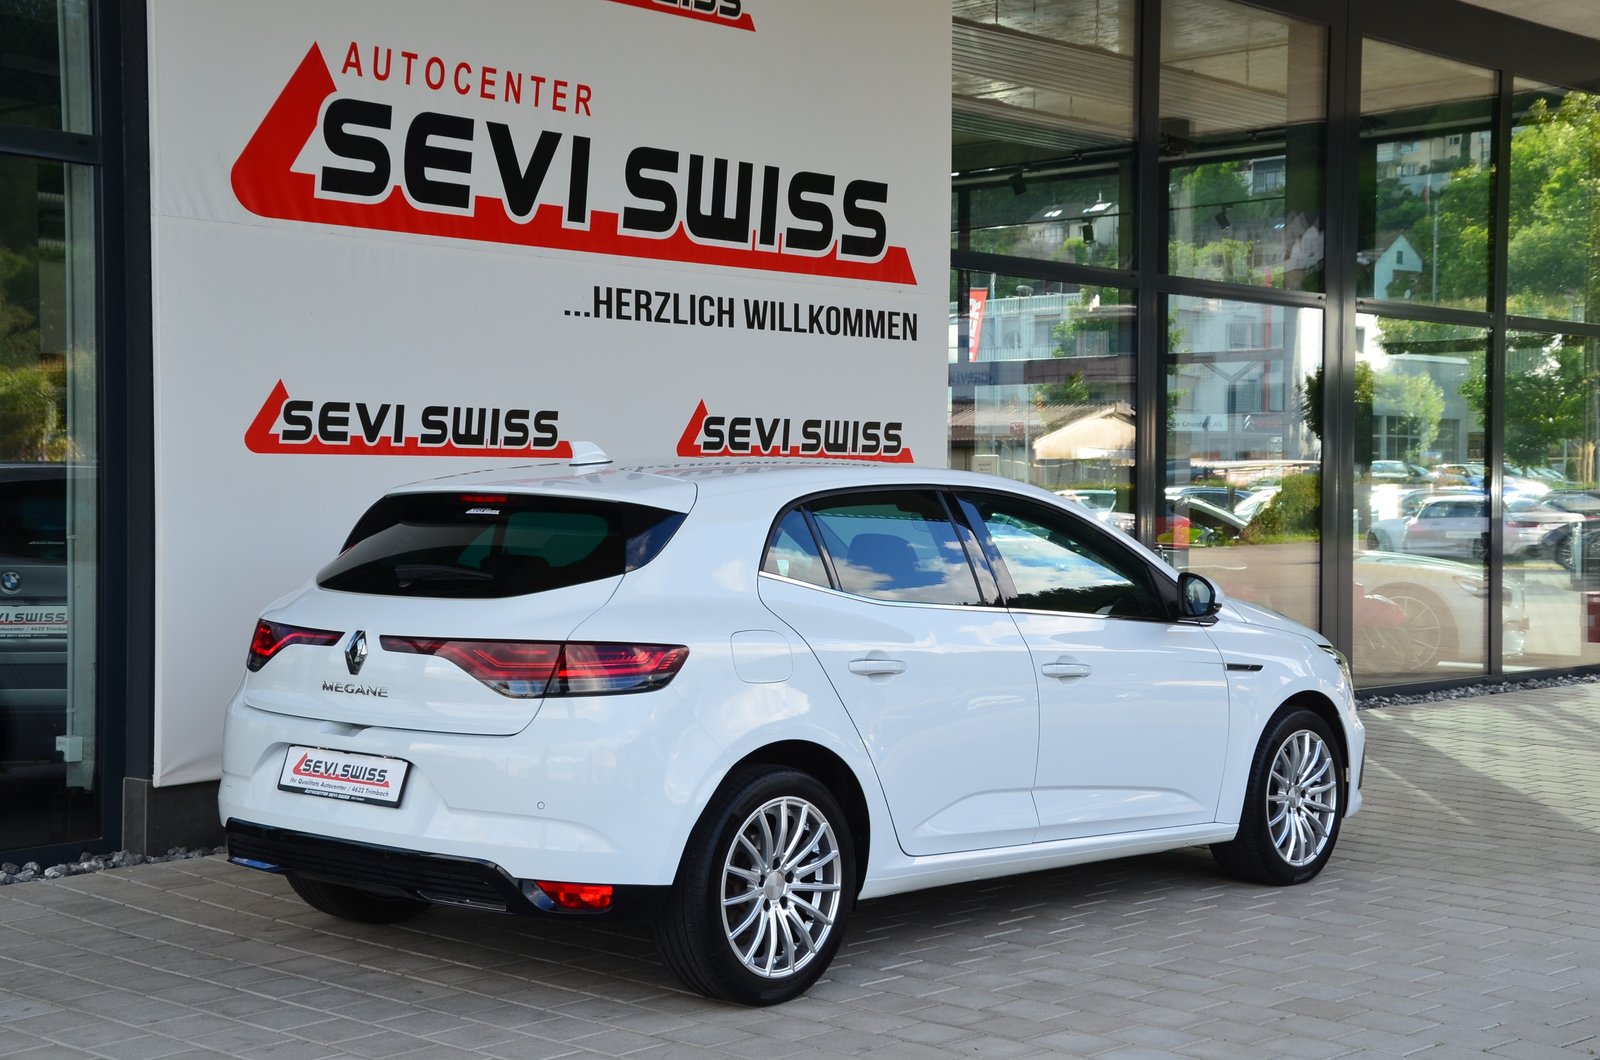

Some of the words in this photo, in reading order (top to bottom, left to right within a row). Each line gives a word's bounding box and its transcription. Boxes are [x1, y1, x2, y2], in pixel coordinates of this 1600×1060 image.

[342, 42, 592, 117] AUTOCENTER
[320, 98, 591, 224] SEVI
[622, 146, 889, 258] SWISS
[564, 285, 735, 328] ...HERZLICH
[743, 298, 918, 342] WILLKOMMEN
[281, 400, 405, 444] SEVI
[420, 405, 559, 447] SWISS
[702, 416, 791, 452] SEVI
[801, 419, 903, 454] SWISS
[14, 612, 66, 622] SWISS
[322, 681, 389, 698] MEGANE
[303, 759, 339, 776] SEVI
[341, 764, 388, 783] SWISS
